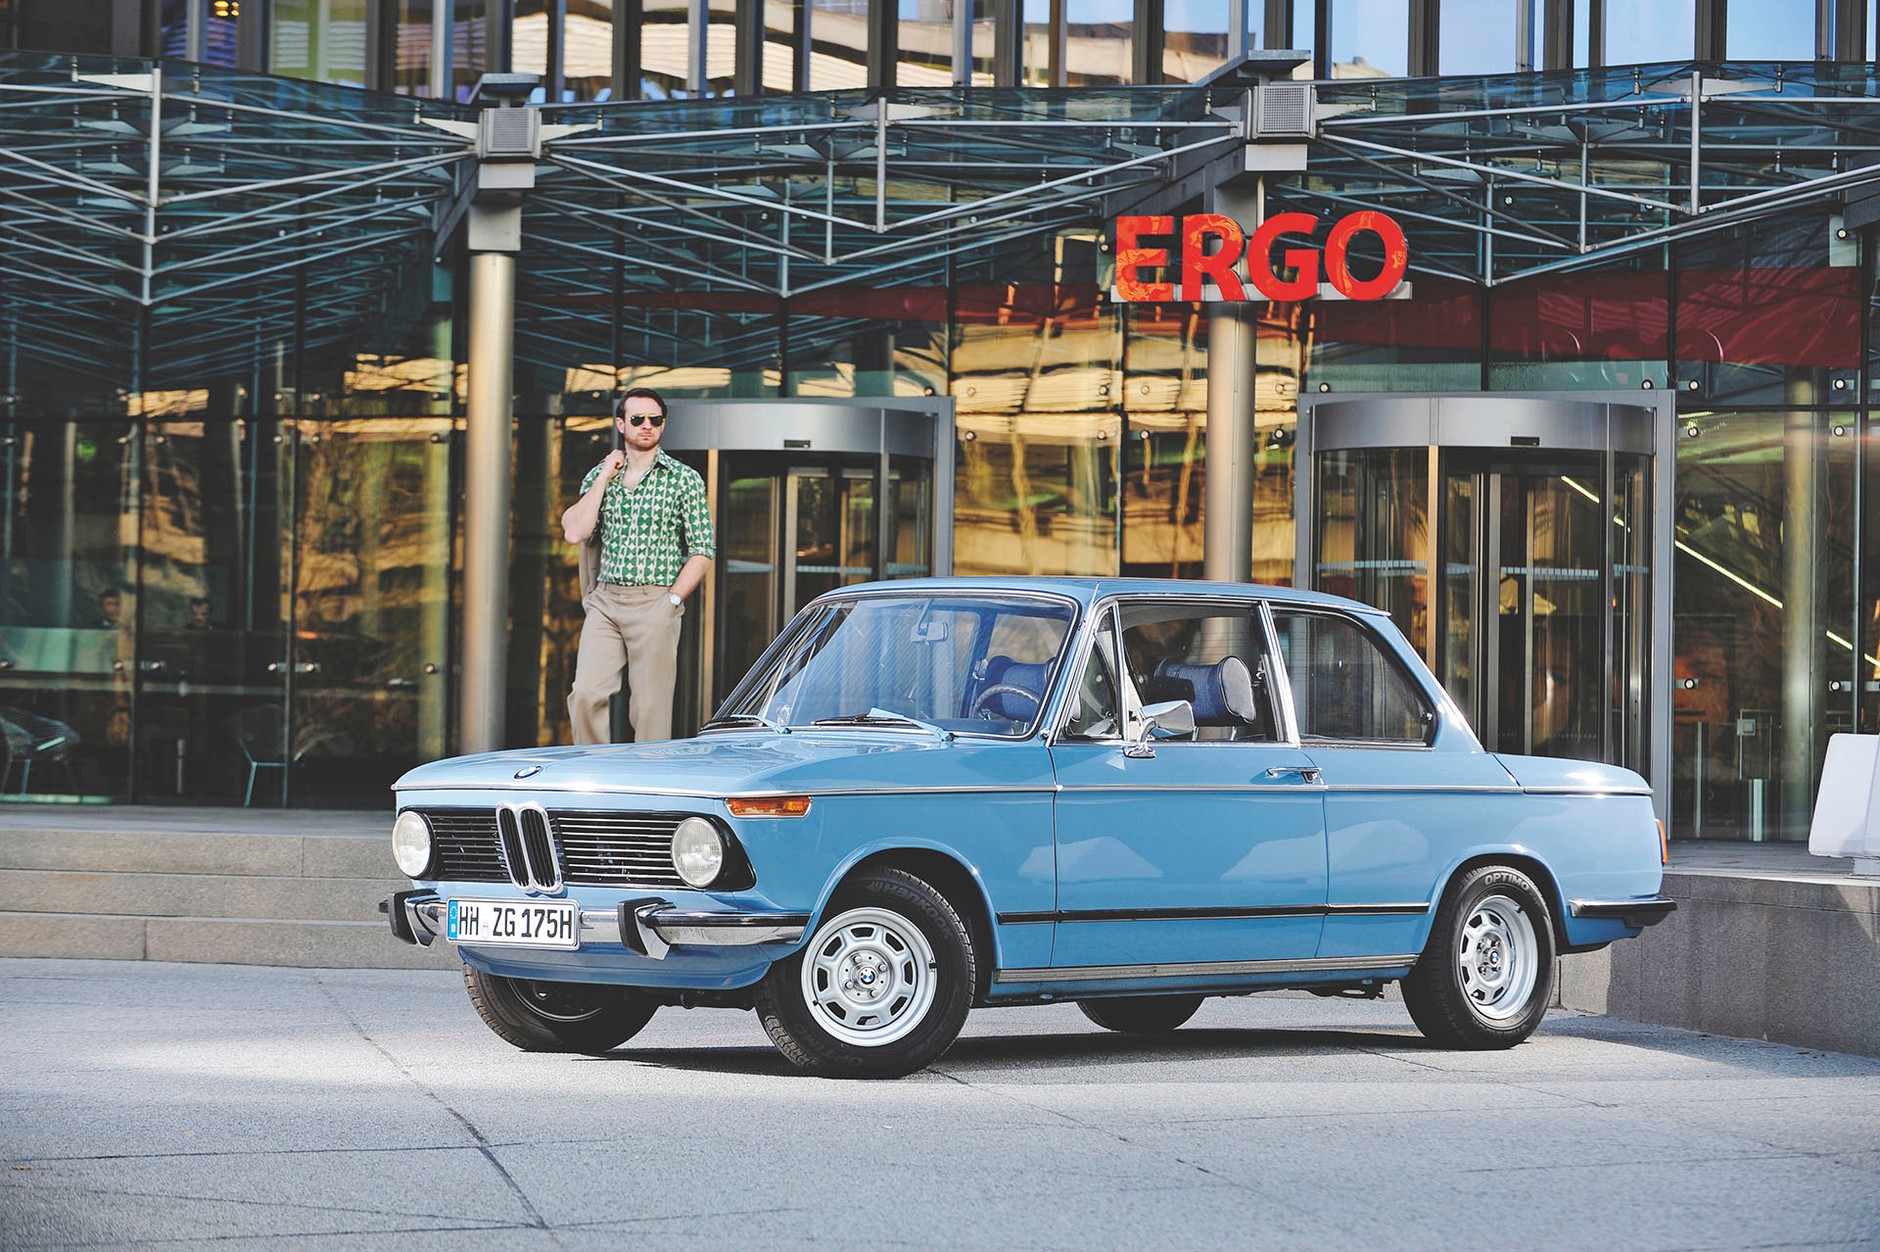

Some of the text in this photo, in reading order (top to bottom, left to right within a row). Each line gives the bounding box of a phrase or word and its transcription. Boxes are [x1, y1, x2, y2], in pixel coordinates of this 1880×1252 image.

[1116, 210, 1408, 302] ERGO
[1485, 873, 1529, 890] OPTIMO
[459, 906, 572, 939] HH ZG 175H
